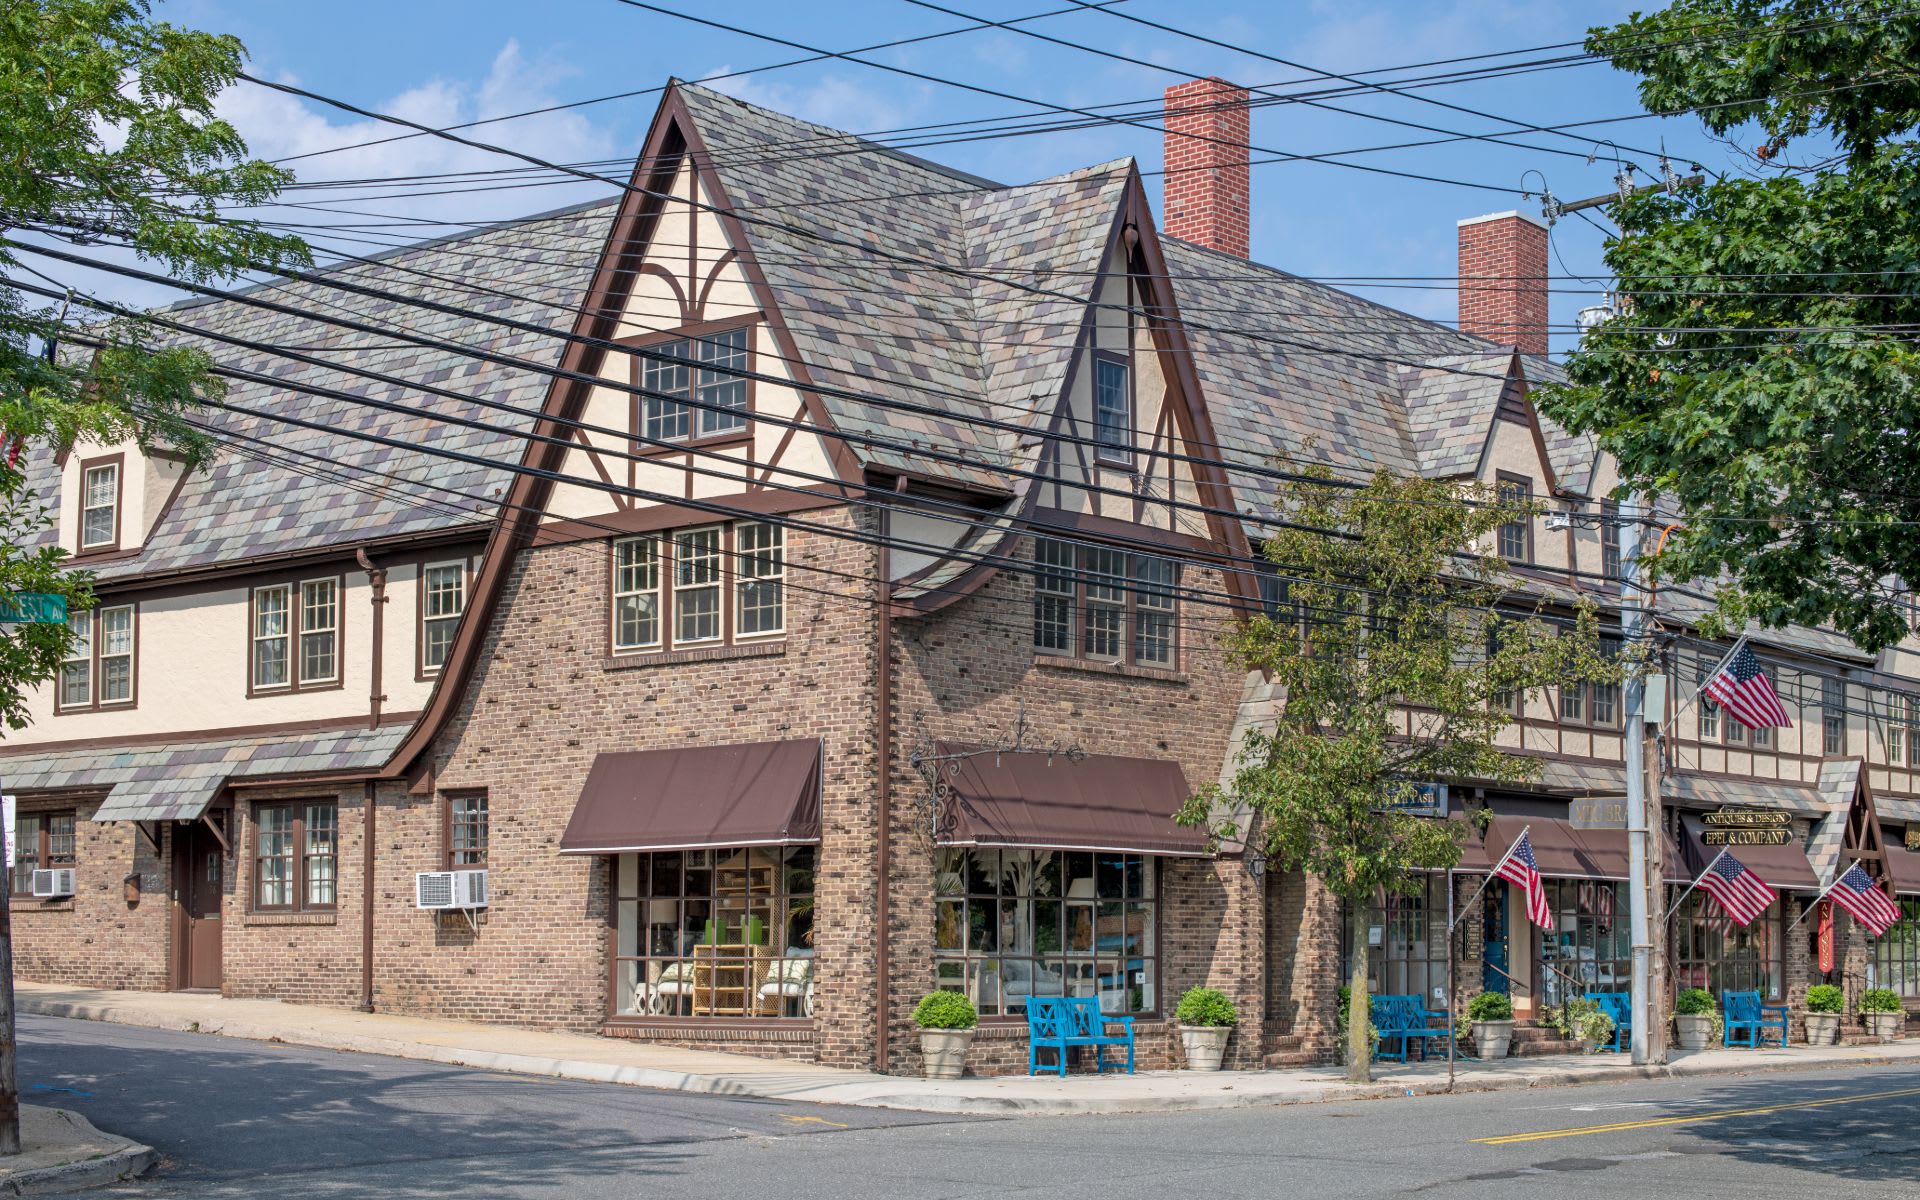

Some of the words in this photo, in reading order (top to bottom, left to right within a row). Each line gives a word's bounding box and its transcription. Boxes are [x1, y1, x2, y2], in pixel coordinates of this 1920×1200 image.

[1705, 815, 1746, 824] ANTIQUES
[1746, 815, 1754, 823] &
[1755, 814, 1785, 823] DESIGN
[1706, 832, 1726, 845] EPEL
[1728, 831, 1736, 844] &
[1738, 831, 1785, 844] COMPANY
